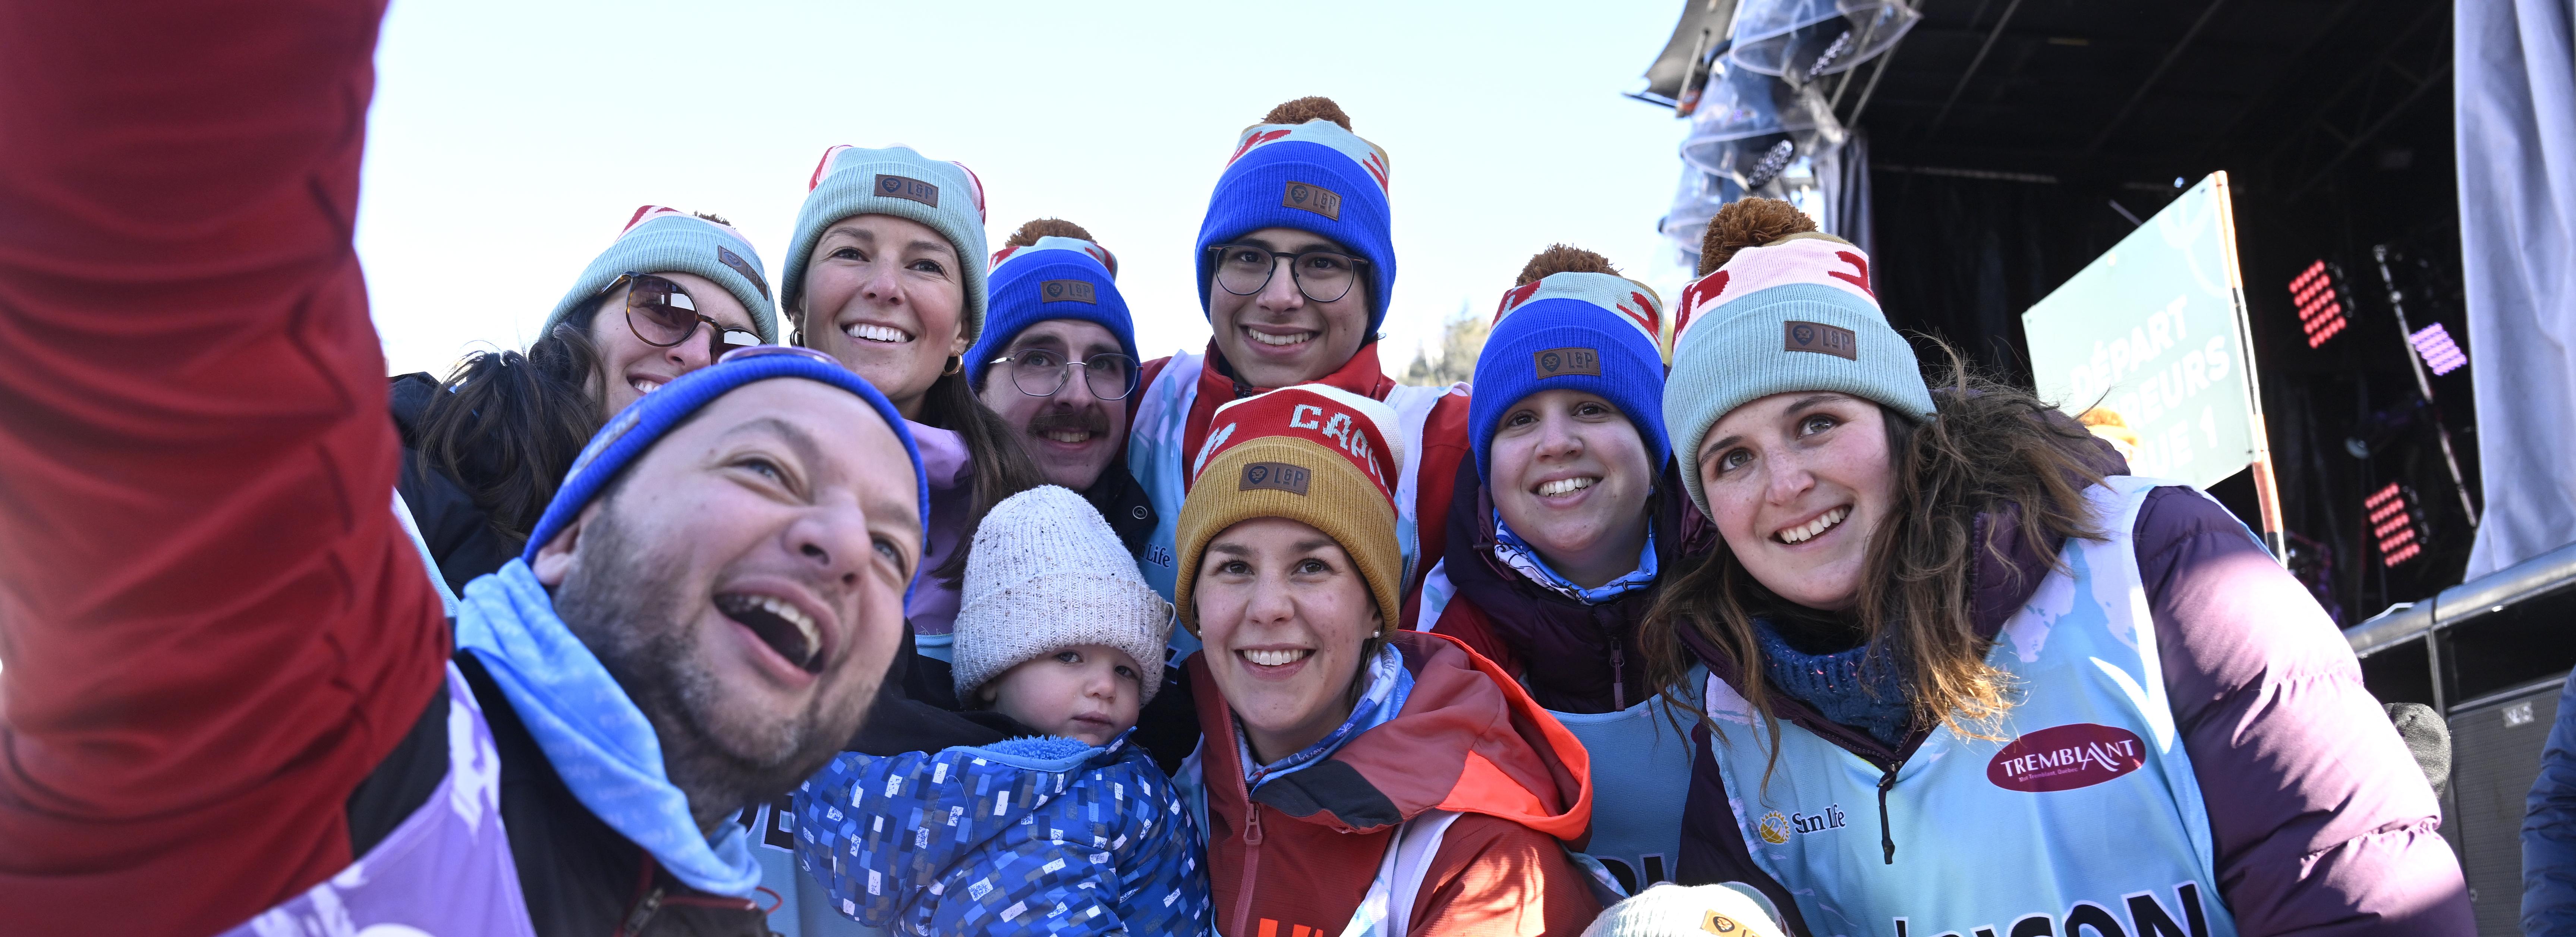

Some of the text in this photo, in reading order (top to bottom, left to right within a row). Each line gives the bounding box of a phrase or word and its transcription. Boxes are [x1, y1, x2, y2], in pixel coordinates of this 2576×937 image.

[907, 181, 933, 199] L&P
[1312, 190, 1336, 211] L&P
[1068, 283, 1090, 298] L&P
[1821, 328, 1849, 351] L&P
[1566, 352, 1593, 369] L&P
[2070, 294, 2188, 408] DÉPART
[2199, 405, 2218, 449] 1
[1273, 467, 1304, 487] L&P
[1146, 544, 1170, 567] Life
[2000, 739, 2133, 777] TREMBLANT
